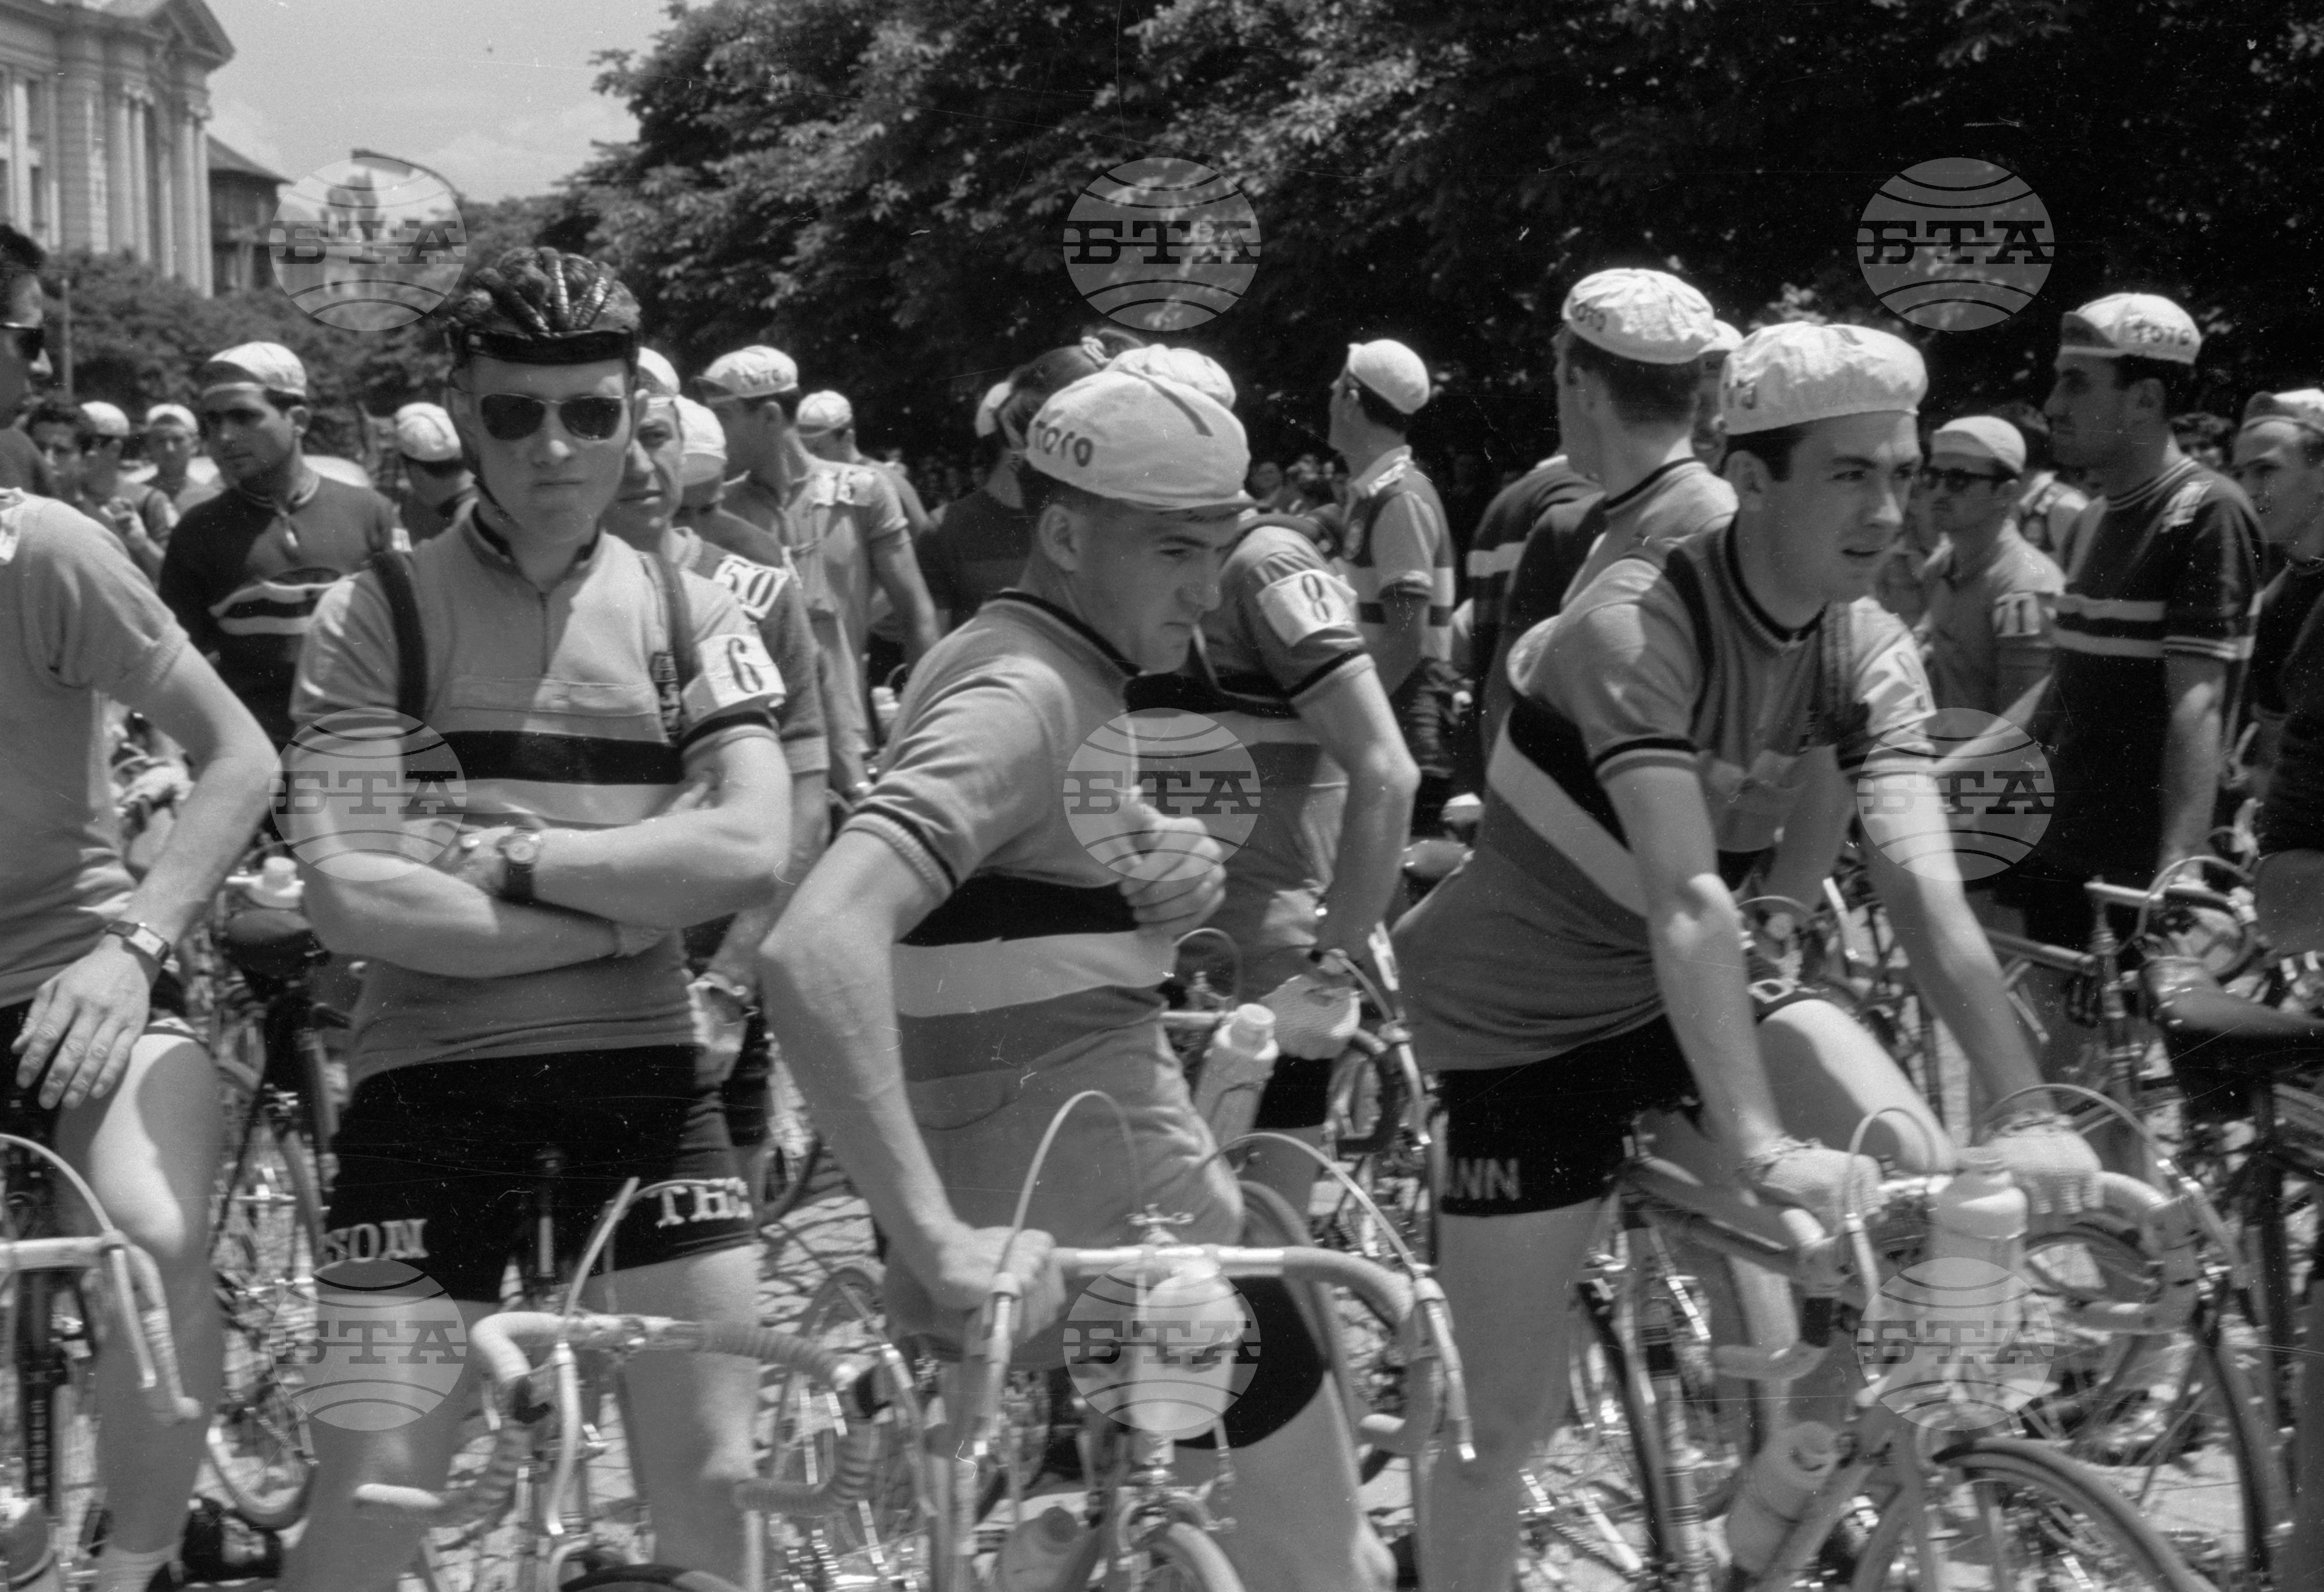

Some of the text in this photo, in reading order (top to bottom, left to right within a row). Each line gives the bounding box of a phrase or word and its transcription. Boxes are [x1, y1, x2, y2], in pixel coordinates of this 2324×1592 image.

[725, 560, 775, 609] 50
[1301, 573, 1331, 623] 8
[726, 637, 763, 694] 6
